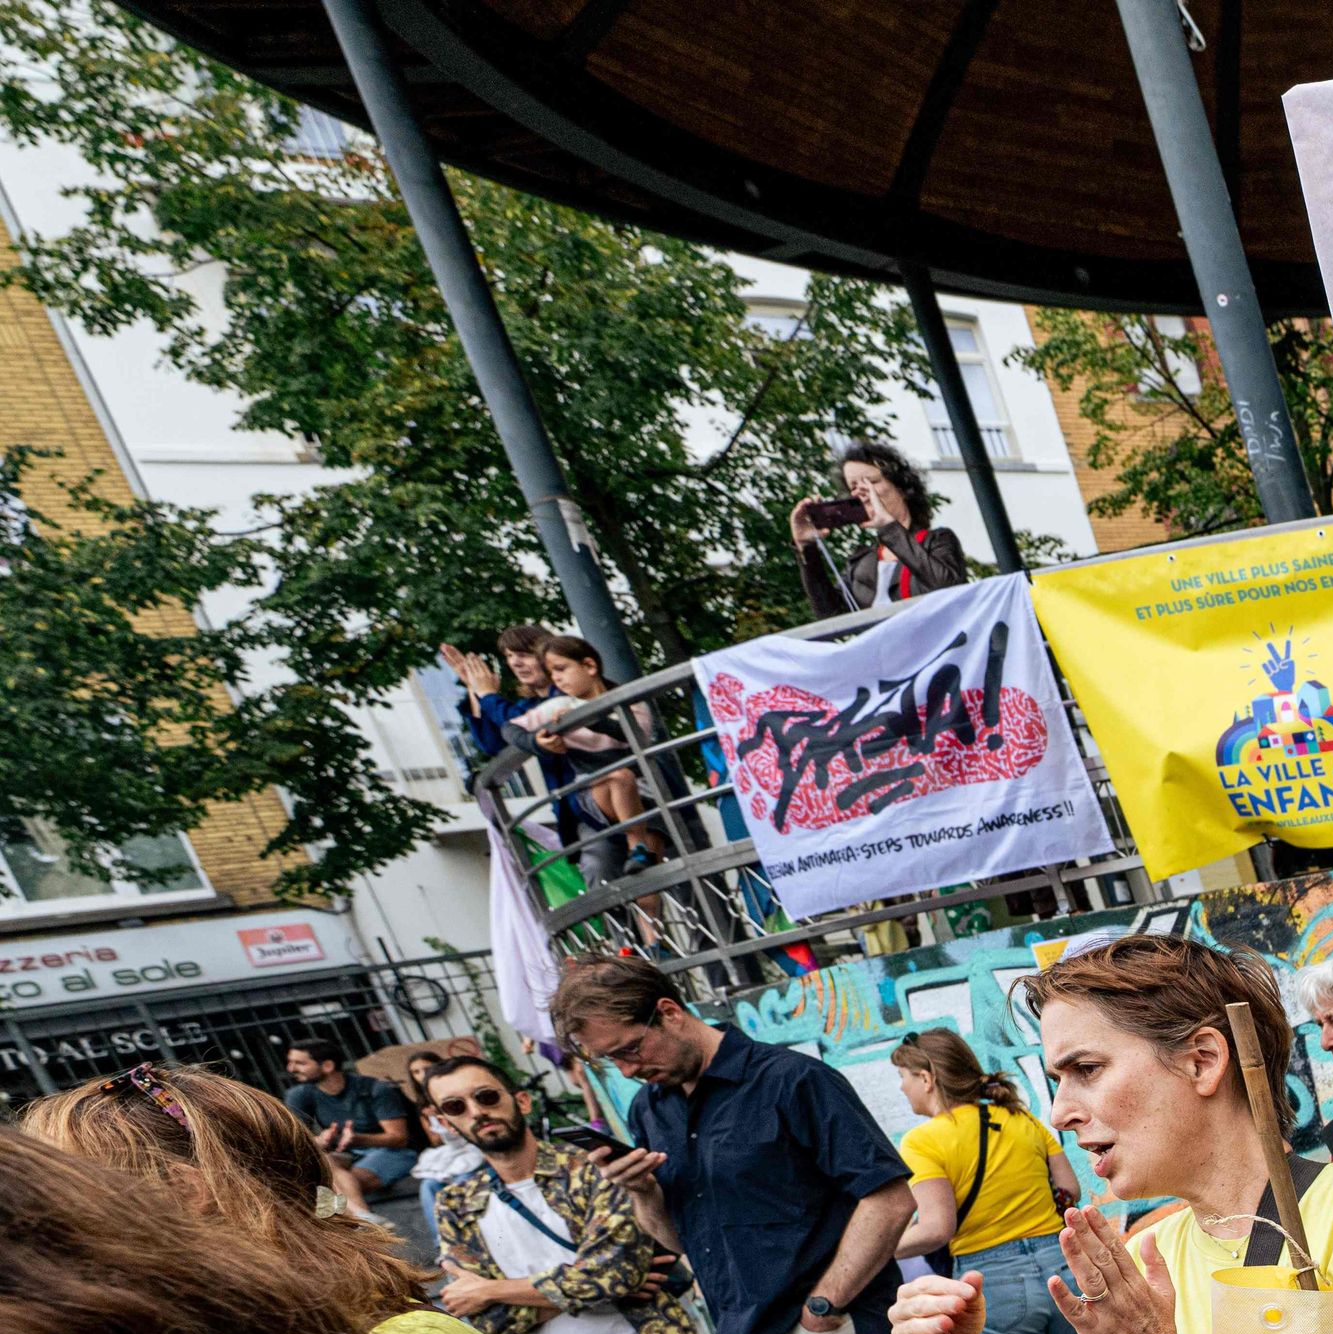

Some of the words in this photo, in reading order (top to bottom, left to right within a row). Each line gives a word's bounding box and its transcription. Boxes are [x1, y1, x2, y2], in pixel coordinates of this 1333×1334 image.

[1171, 576, 1203, 592] UNE
[1206, 569, 1247, 586] VILLE
[1250, 562, 1289, 580] PLUS
[1136, 606, 1151, 621] ET
[1155, 600, 1193, 617] PLUS
[1196, 591, 1235, 610] SÛRE
[1238, 586, 1281, 603] POUR
[1284, 579, 1318, 595] NOS
[1219, 770, 1252, 789] LA
[1257, 758, 1325, 782] VILLE
[905, 824, 973, 849] TOWARDS
[257, 940, 313, 959] Jupiler
[61, 968, 97, 993] al
[112, 959, 203, 986] sole
